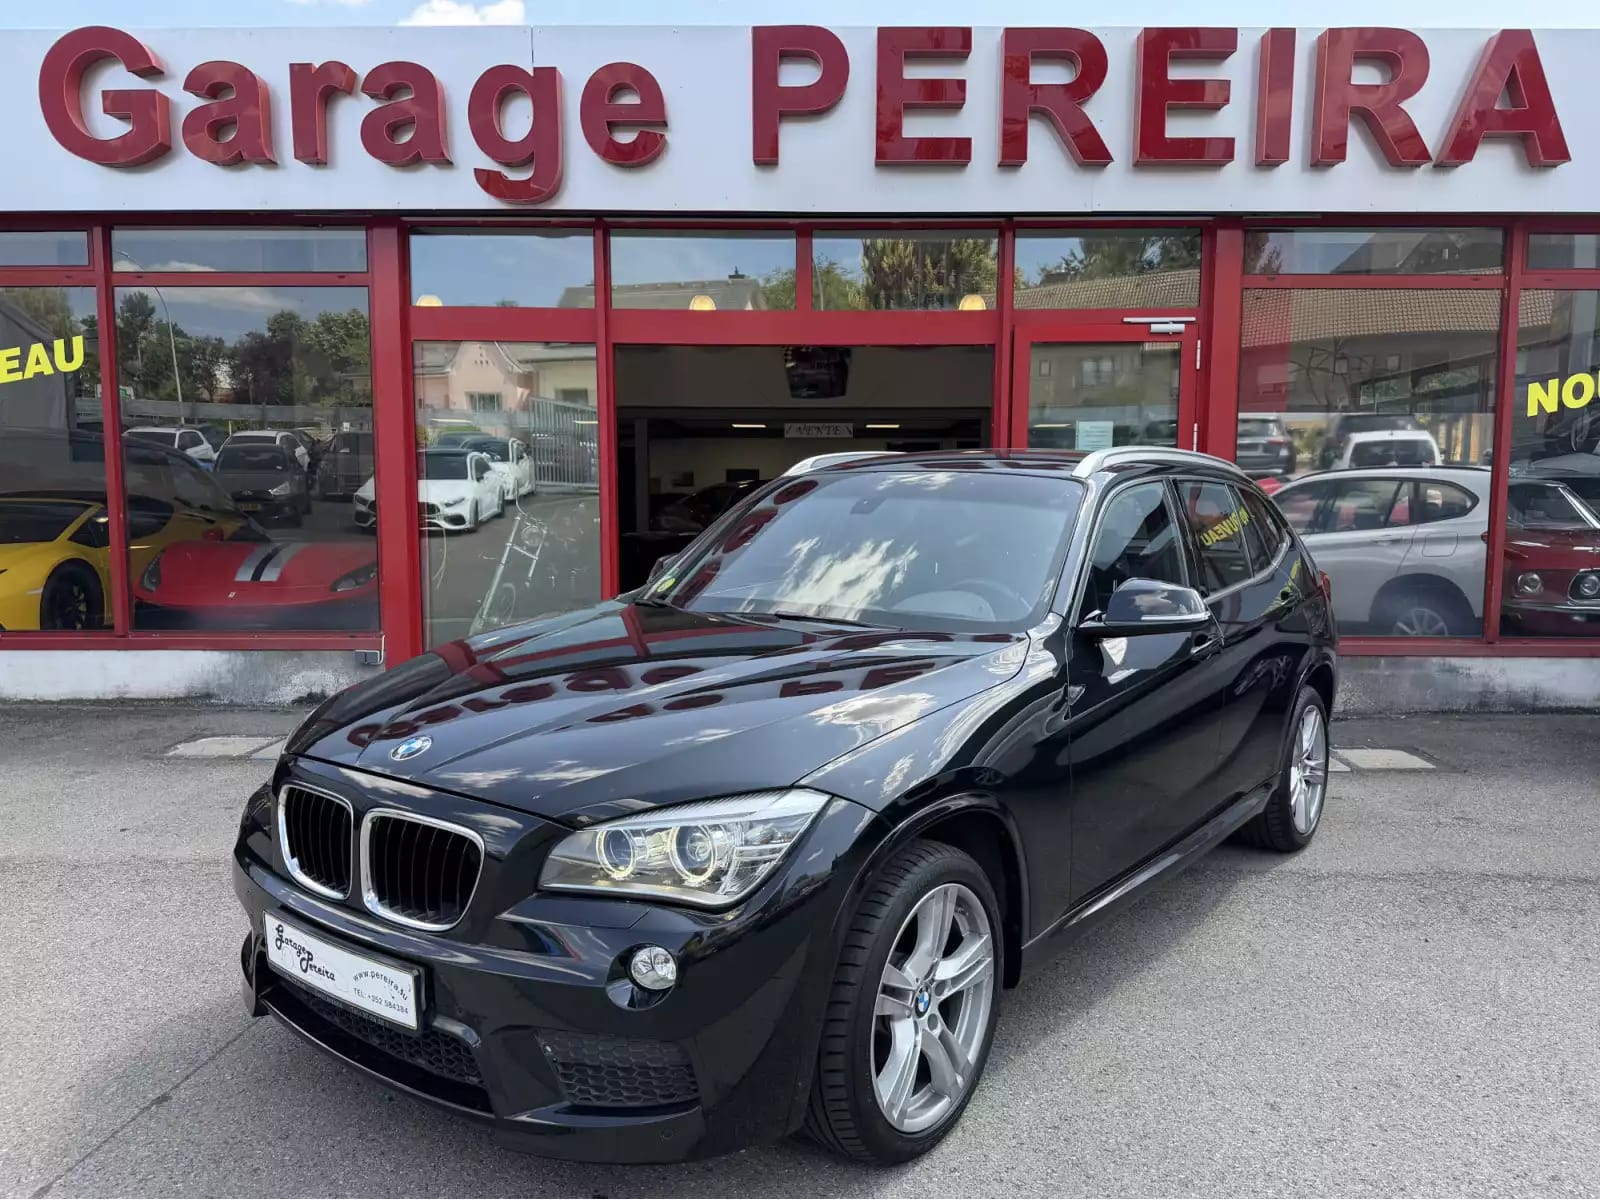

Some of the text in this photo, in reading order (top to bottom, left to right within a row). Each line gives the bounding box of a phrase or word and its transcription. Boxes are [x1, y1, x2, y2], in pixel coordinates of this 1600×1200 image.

[39, 25, 1571, 205] Garage PEREIRA
[0, 336, 84, 384] EAU
[1527, 370, 1600, 417] NO
[275, 924, 306, 957] Garage
[300, 950, 336, 982] Pereira
